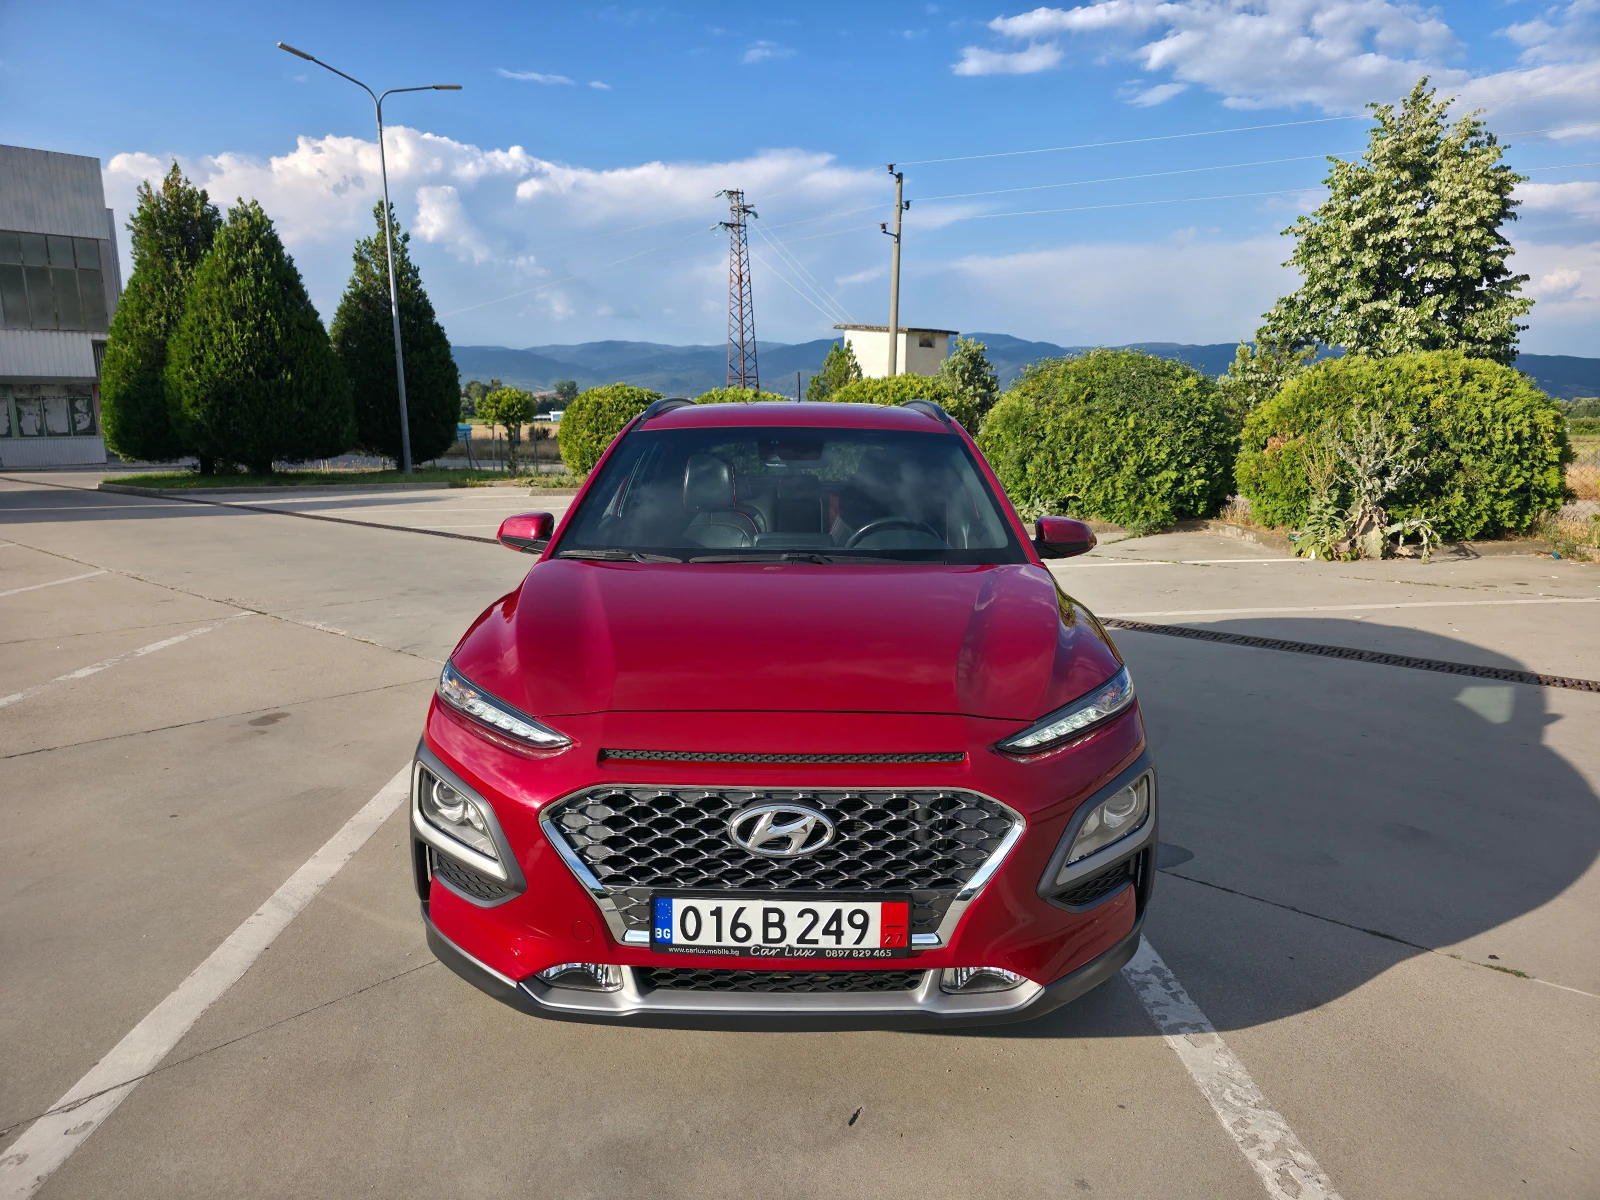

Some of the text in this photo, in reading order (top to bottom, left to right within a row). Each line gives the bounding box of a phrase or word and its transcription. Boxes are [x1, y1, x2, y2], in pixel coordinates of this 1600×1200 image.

[654, 927, 671, 939] BG
[668, 947, 740, 956] www.carlux.mobile.bg
[750, 945, 816, 957] Car Lux
[825, 949, 892, 957] 0897 829 465
